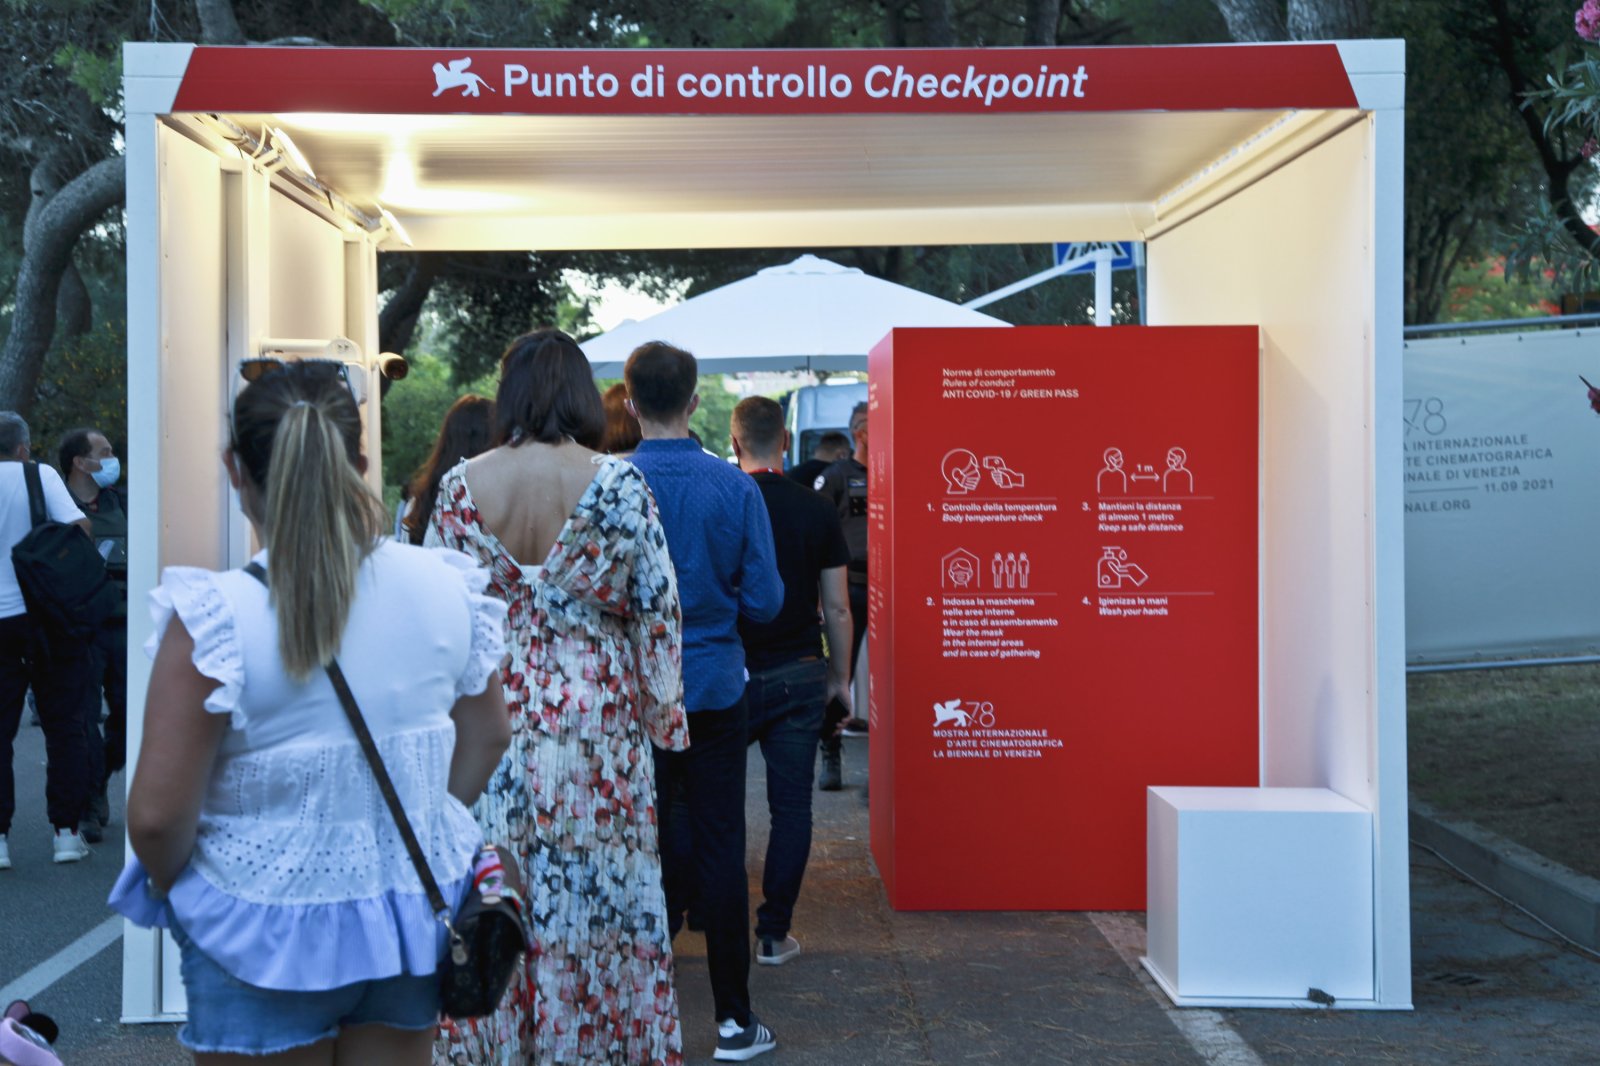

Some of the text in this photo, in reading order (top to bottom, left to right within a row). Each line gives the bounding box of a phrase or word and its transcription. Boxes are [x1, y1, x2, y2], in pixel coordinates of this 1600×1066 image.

[503, 64, 1088, 106] Punto di controllo Checkpoint
[943, 368, 1055, 379] Norme di comportamento
[943, 379, 1015, 387] Rules of conduct
[943, 390, 965, 398] ANTI
[1020, 390, 1053, 398] GREEN
[1055, 390, 1079, 398] PASS
[1404, 397, 1447, 436] 78
[1413, 434, 1528, 451] INTERNAZIONALE
[1426, 448, 1553, 466] CINEMATOGRAFICA
[1137, 464, 1142, 472] 1
[1446, 471, 1459, 480] DI
[1464, 466, 1520, 479] VENEZIA
[1484, 479, 1554, 493] 11.09 2021
[942, 503, 981, 512] Controllo
[983, 503, 1003, 512] della
[1005, 504, 1057, 514] temperatura
[1082, 503, 1181, 511] 3. Mantieni la distanza
[1404, 499, 1471, 513] NALE.ORG
[942, 514, 1043, 523] Body temperature check
[1099, 513, 1106, 521] di
[1108, 513, 1139, 521] almeno
[1099, 523, 1120, 534] Keep
[1128, 523, 1146, 531] safe
[1148, 523, 1183, 531] distance
[927, 598, 1034, 606] 2. Indossa la mascherina
[1082, 597, 1168, 608] 4. Igienizza le mani
[943, 608, 963, 616] nelle
[985, 608, 1015, 616] interne
[1099, 607, 1168, 618] Wash your hands
[950, 618, 958, 626] in
[981, 618, 988, 626] di
[990, 618, 1058, 626] assembramento
[943, 629, 1003, 637] Wear the mask
[943, 639, 951, 647] in
[952, 639, 966, 647] the
[967, 639, 1000, 647] internal
[943, 649, 958, 657] and
[960, 649, 968, 657] in
[990, 649, 1000, 657] of
[1000, 649, 1040, 659] gathering
[965, 701, 995, 728] 78
[947, 740, 1063, 748] D'ARTE CINEMATOGRAFICA
[947, 750, 990, 758] BIENNALE
[993, 750, 1002, 758] DI
[1004, 750, 1042, 758] VENEZIA
